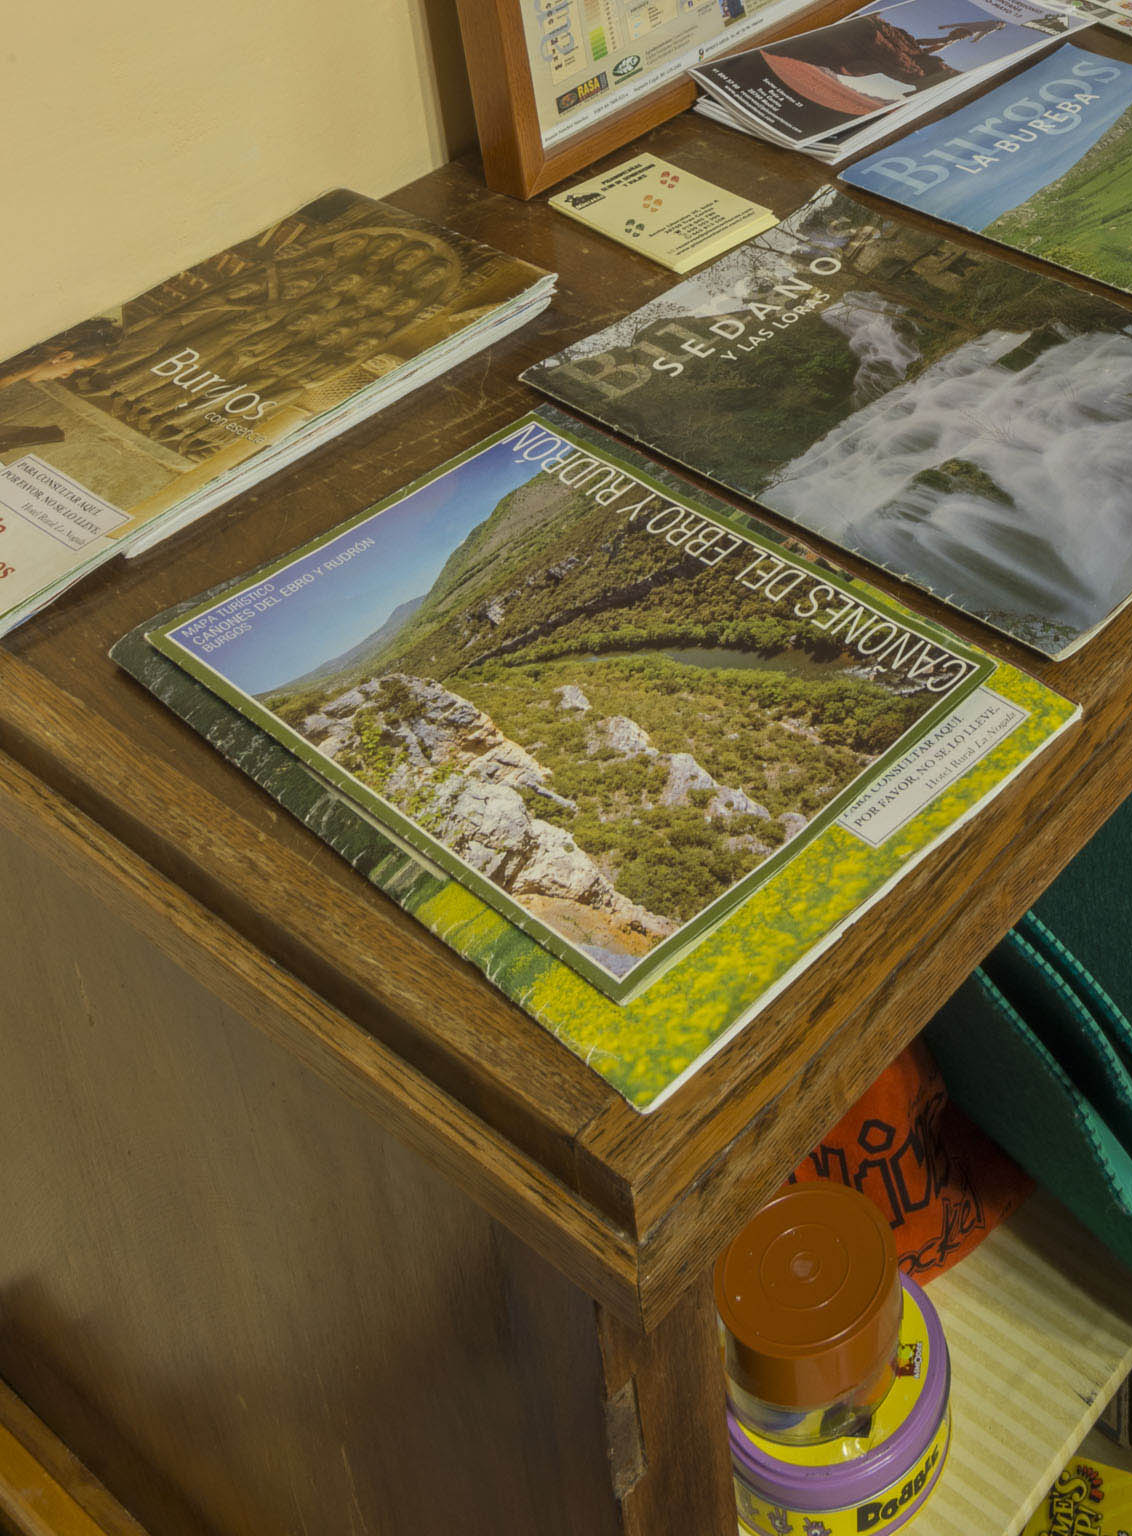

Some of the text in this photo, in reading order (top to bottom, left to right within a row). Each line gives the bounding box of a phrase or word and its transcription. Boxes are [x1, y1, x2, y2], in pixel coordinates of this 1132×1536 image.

[576, 78, 601, 102] RASA
[860, 61, 1121, 197] Burgos
[955, 92, 1101, 175] LA BUREBA
[652, 256, 842, 378] SEDANO
[720, 290, 831, 364] Y LAS LORAS
[150, 347, 279, 421] Burgos
[204, 412, 228, 425] con
[1, 469, 20, 485] POR
[16, 460, 38, 478] PARA
[191, 535, 376, 647] CAÑONES DEL EBRO Y RUDRÓN
[503, 423, 970, 694] CAÑONES DEL EBRO Y RUDRÓN
[180, 582, 276, 639] MAPA TURÍSTICO
[200, 621, 253, 654] BURGOS
[853, 805, 882, 828] POR
[877, 772, 921, 809] FAVOR,
[915, 758, 936, 778] NO
[933, 747, 949, 764] SE
[947, 734, 966, 752] LO
[869, 738, 936, 795] CONSULTAR
